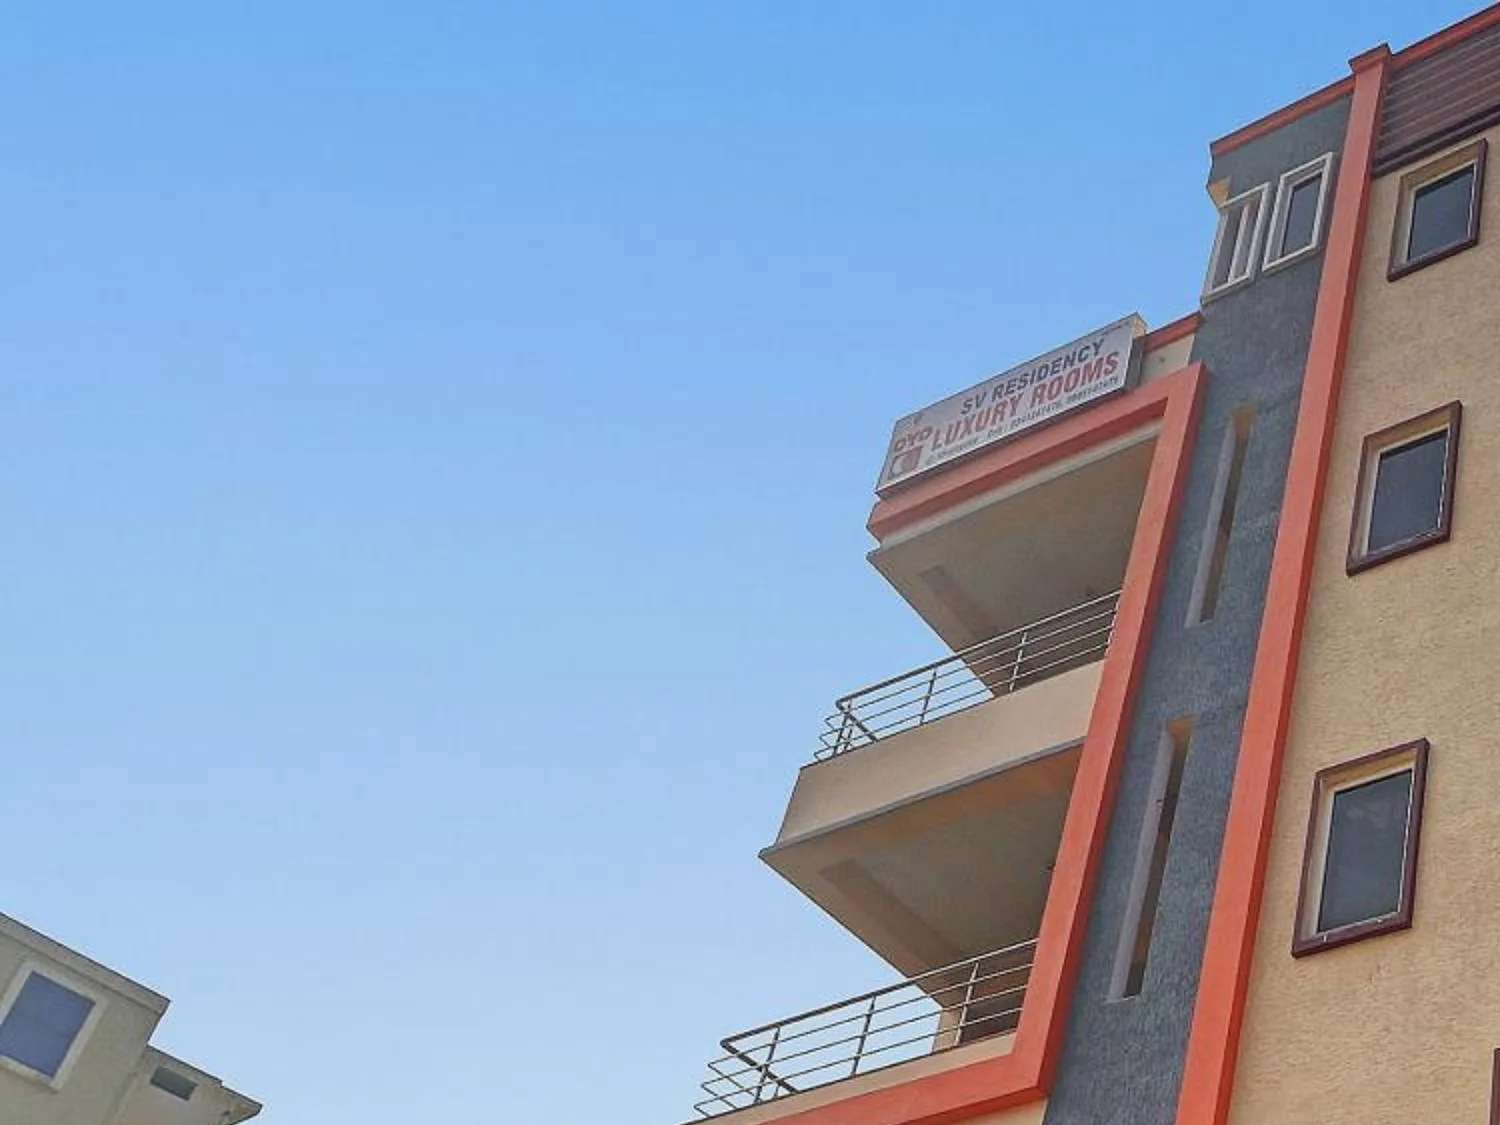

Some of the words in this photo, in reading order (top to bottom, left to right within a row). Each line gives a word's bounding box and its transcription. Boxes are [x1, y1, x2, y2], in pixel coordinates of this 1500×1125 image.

[931, 392, 1024, 451] LUXURY
[1031, 351, 1119, 408] ROOMS
[961, 392, 987, 415] SV
[991, 339, 1105, 401] RESIDENCY
